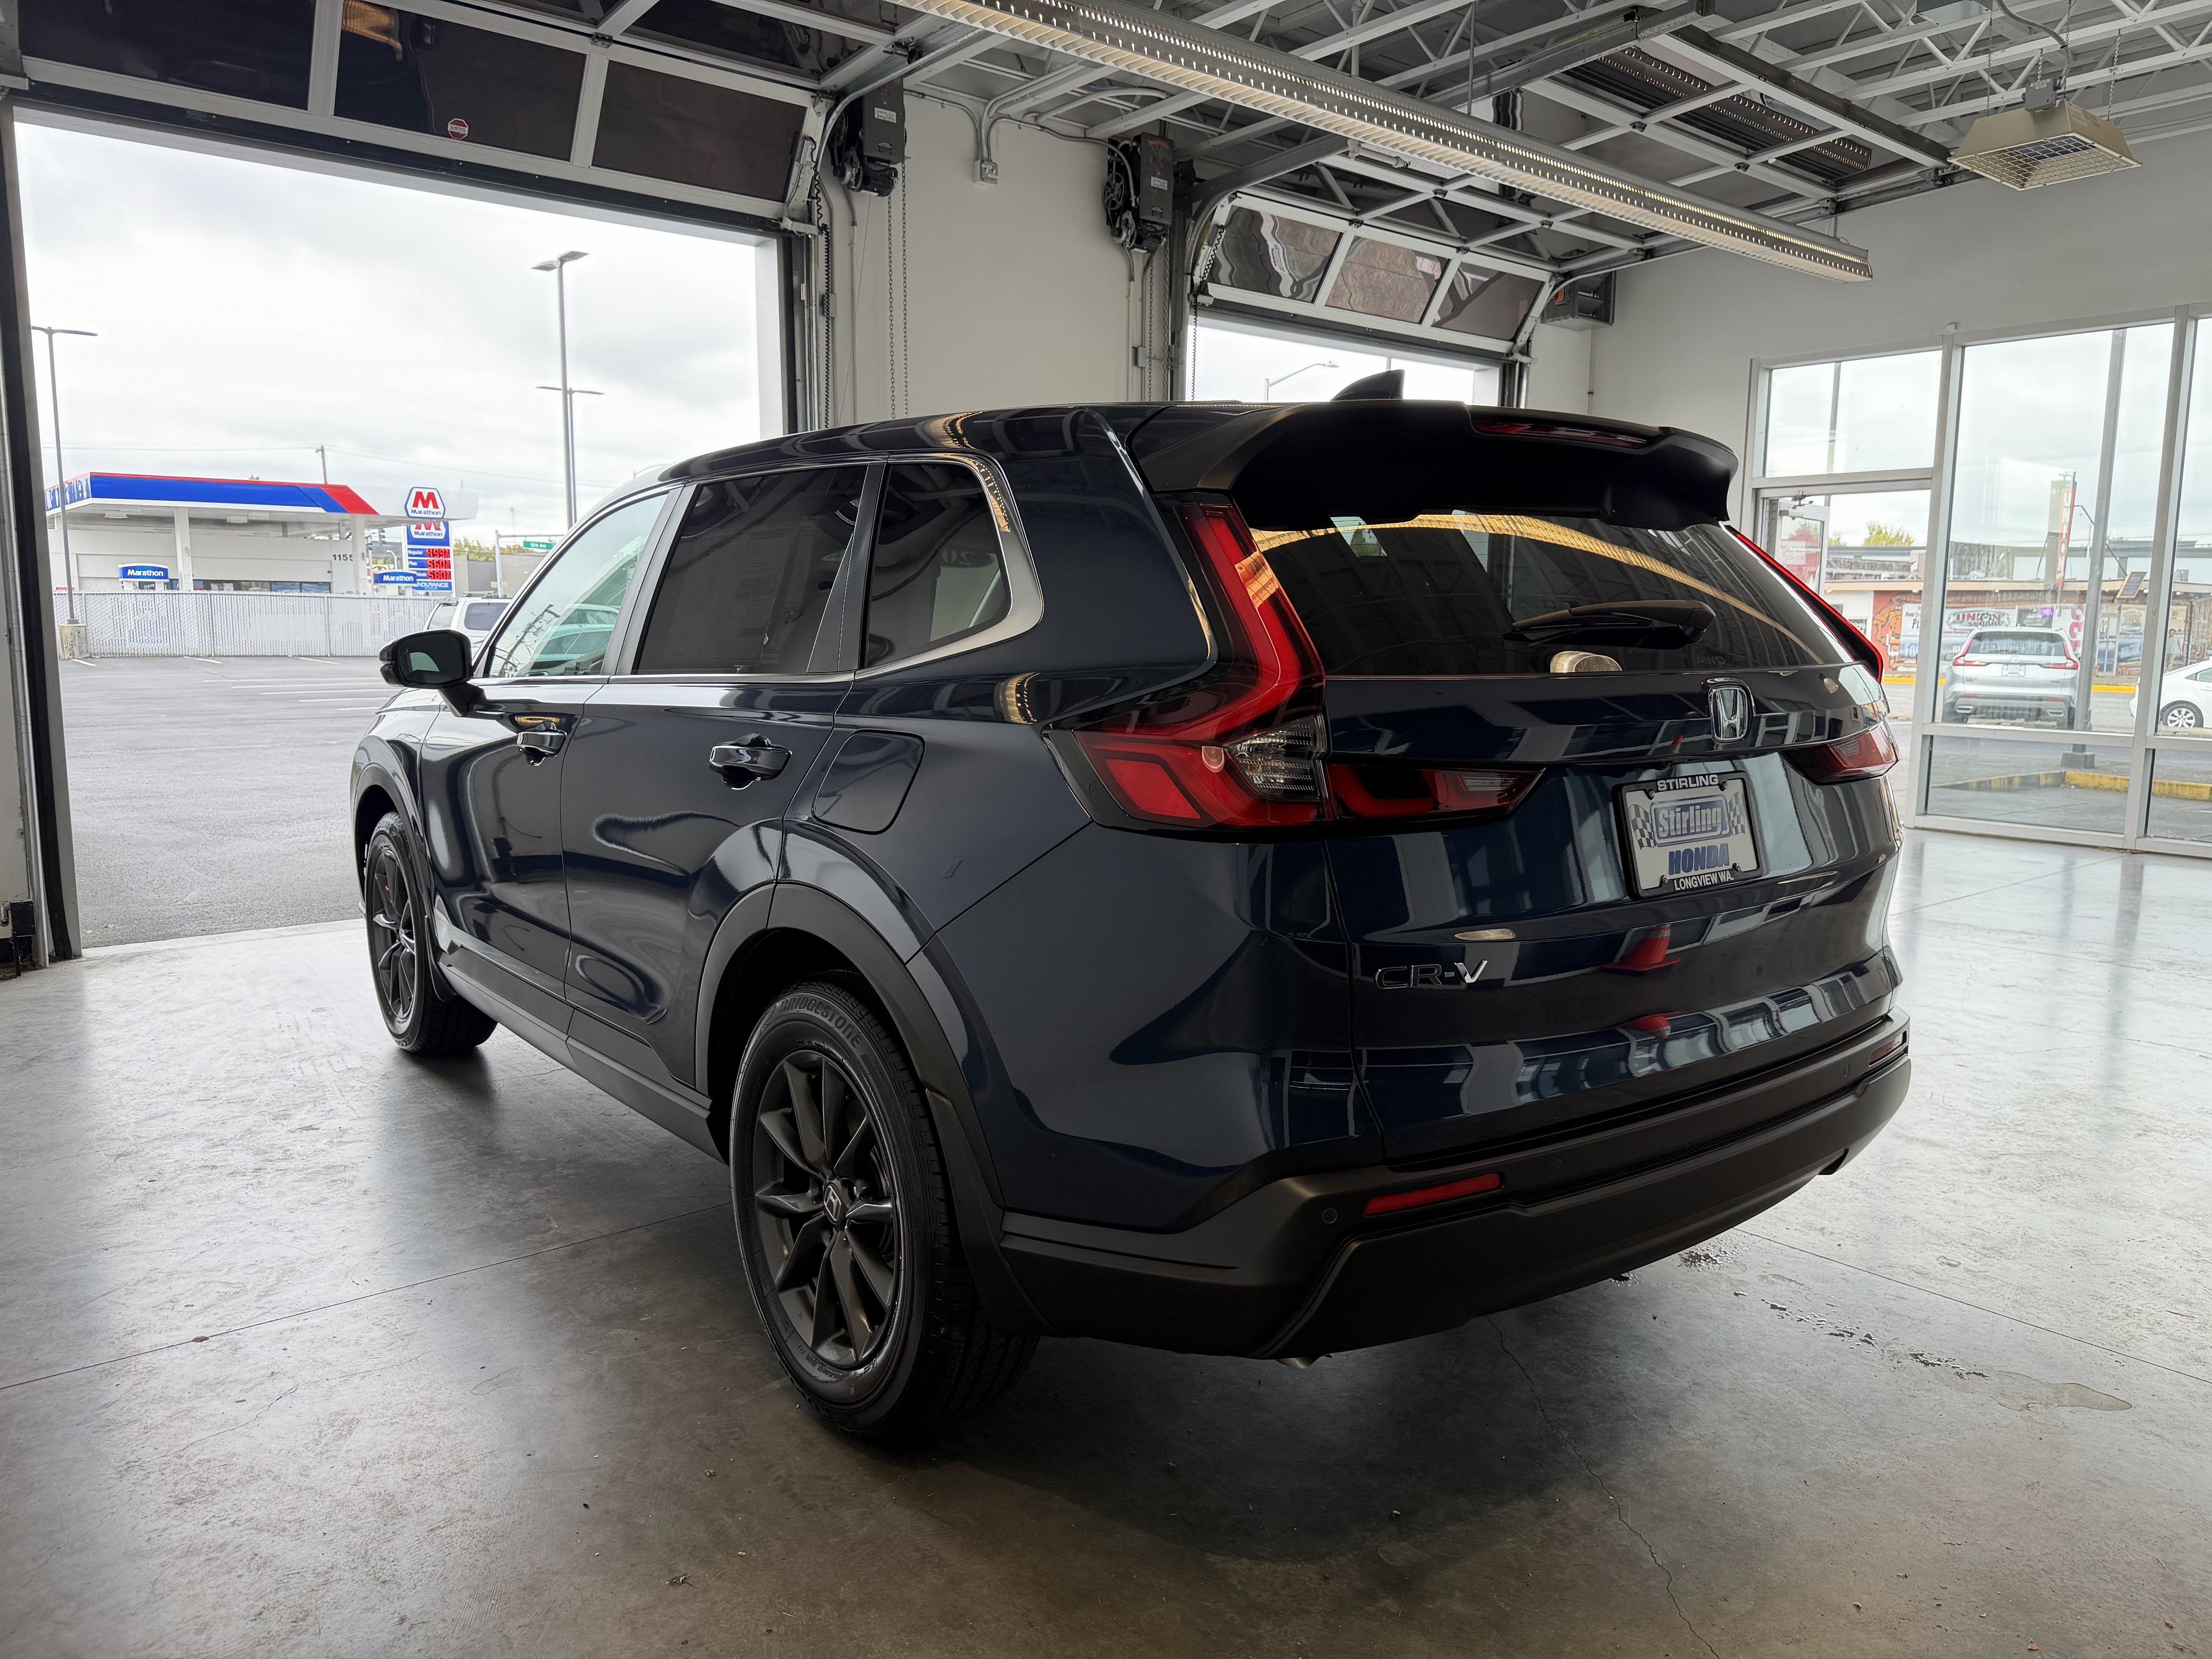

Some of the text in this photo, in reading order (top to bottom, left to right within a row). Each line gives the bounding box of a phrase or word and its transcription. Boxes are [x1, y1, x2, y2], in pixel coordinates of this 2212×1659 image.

[1697, 656, 1726, 665] AWD
[1657, 775, 1719, 791] STIRLING
[1659, 805, 1722, 837] Stirling
[1668, 843, 1729, 875] HONDA
[1674, 871, 1734, 891] LONGVIEW WA.
[1374, 960, 1488, 989] CR-V
[781, 996, 864, 1048] BRIDGESTONE
